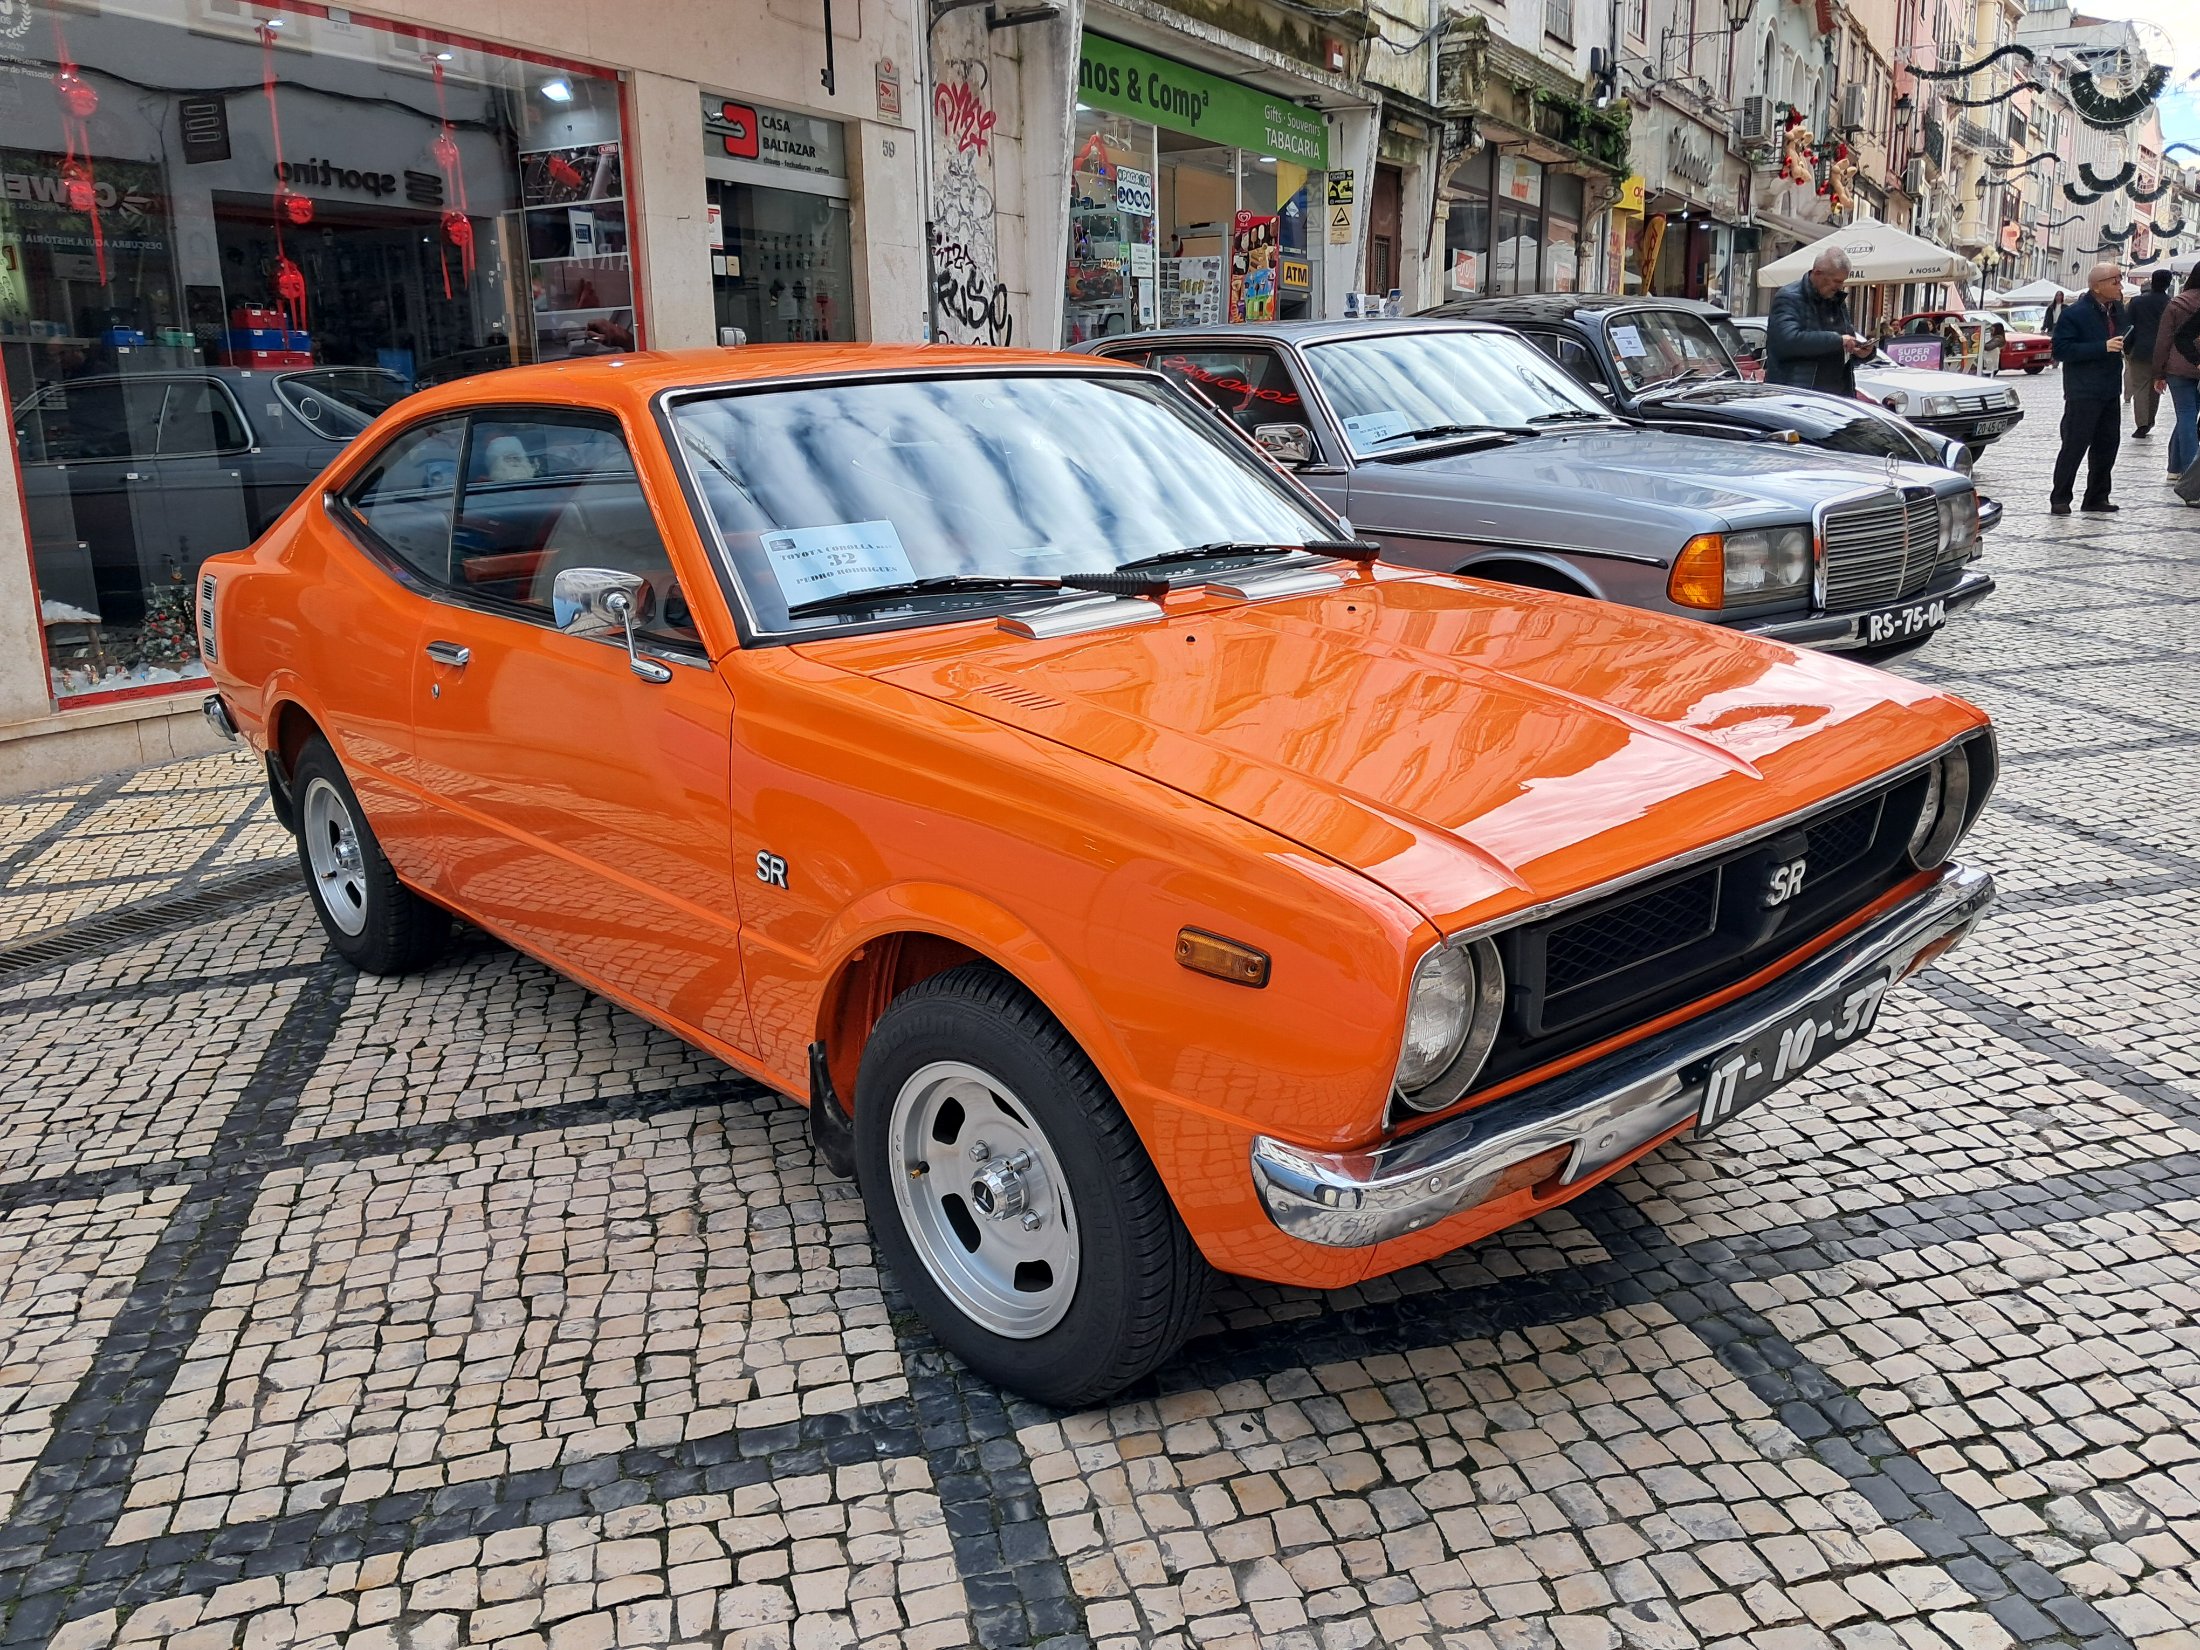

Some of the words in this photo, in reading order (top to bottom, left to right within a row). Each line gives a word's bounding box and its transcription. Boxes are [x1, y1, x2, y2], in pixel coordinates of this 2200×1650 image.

[1127, 67, 1143, 104] &
[762, 116, 791, 133] CASA
[1264, 104, 1282, 125] Gifts
[1287, 112, 1321, 137] Souvenirs
[763, 137, 816, 158] BALTAZAR
[882, 140, 895, 158] 59
[1264, 127, 1321, 160] TABACARIA
[1285, 265, 1307, 284] ATM
[1897, 347, 1930, 356] SUPER
[1898, 354, 1928, 363] FOOD
[781, 548, 823, 561] TOYOTA
[826, 543, 873, 553] COROLLA
[827, 552, 857, 567] 32
[796, 571, 834, 585] PEDRO
[837, 566, 898, 576] RODRIGUES
[756, 850, 789, 890] SR
[1766, 858, 1806, 906] SR
